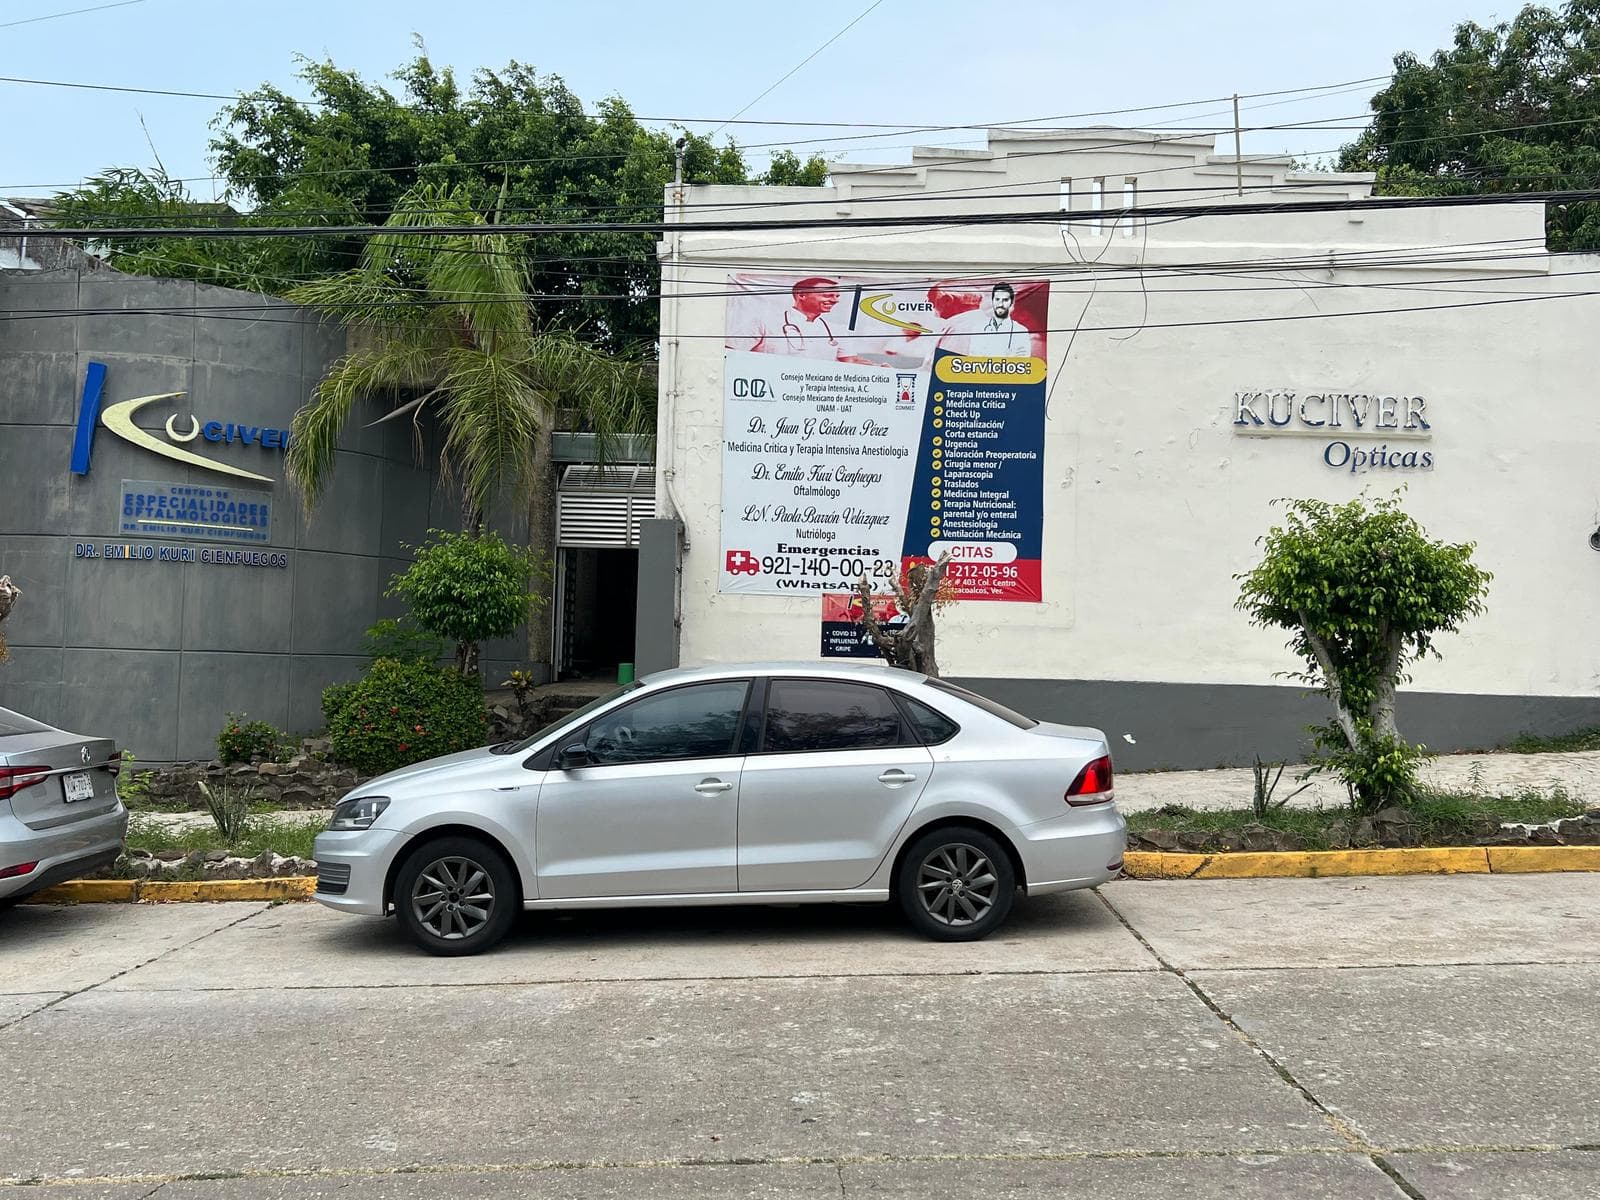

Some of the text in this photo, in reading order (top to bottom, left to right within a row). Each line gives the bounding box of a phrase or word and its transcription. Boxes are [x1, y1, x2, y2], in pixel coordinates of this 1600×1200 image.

[951, 358, 1032, 374] Servicios:
[780, 373, 804, 382] Consejo
[805, 373, 833, 382] Mexicano
[834, 374, 842, 382] de
[843, 374, 870, 383] Medicina
[805, 384, 826, 393] Terapia
[827, 384, 856, 393] Intensiva,
[782, 393, 805, 403] Consejo
[806, 393, 834, 403] Mexicano
[835, 394, 843, 402] de
[946, 390, 1017, 402] Terapia Intensiva y
[816, 404, 836, 413] UNAM
[840, 404, 852, 413] UAT
[945, 399, 980, 409] Medicina
[945, 409, 981, 420] Check Up
[746, 416, 889, 441] Dr. Juan G. Córdova Pérez
[945, 420, 1005, 430] Hospitalización/
[944, 429, 999, 439] Corta estancia
[727, 441, 762, 453] Medicina
[789, 445, 795, 456] y
[796, 443, 824, 457] Terapia
[825, 443, 860, 455] Intensiva
[944, 440, 978, 450] Urgencia
[944, 449, 984, 459] Valoración
[1323, 441, 1434, 473] Opticas
[750, 462, 883, 488] Dr. Emilio Kuri Cienfuegos
[944, 479, 980, 488] Traslados
[171, 487, 212, 497] CENTRO
[793, 485, 841, 500] Oftalmólogo
[943, 489, 1010, 500] Medicina Integral
[124, 493, 268, 517] ESPECIALIDADES
[943, 499, 1017, 510] Terapia Nutricional:
[123, 506, 268, 528] OFTALMOLOGICAS
[771, 505, 801, 523] Paola
[801, 505, 840, 524] Barrón
[842, 507, 891, 531] Velázquez
[943, 510, 1018, 520] parental y/o enteral
[142, 524, 177, 534] EMILIO
[180, 526, 205, 535] KURI
[942, 529, 1022, 539] Ventilación Mecánica
[795, 528, 836, 543] Nutrióloga
[75, 543, 288, 568] DR. EMILIO KURI CIENFUEGOS
[777, 543, 880, 557] Emergencias
[951, 546, 993, 558] CITAS
[977, 578, 991, 587] Col.
[992, 579, 1016, 587] Centro
